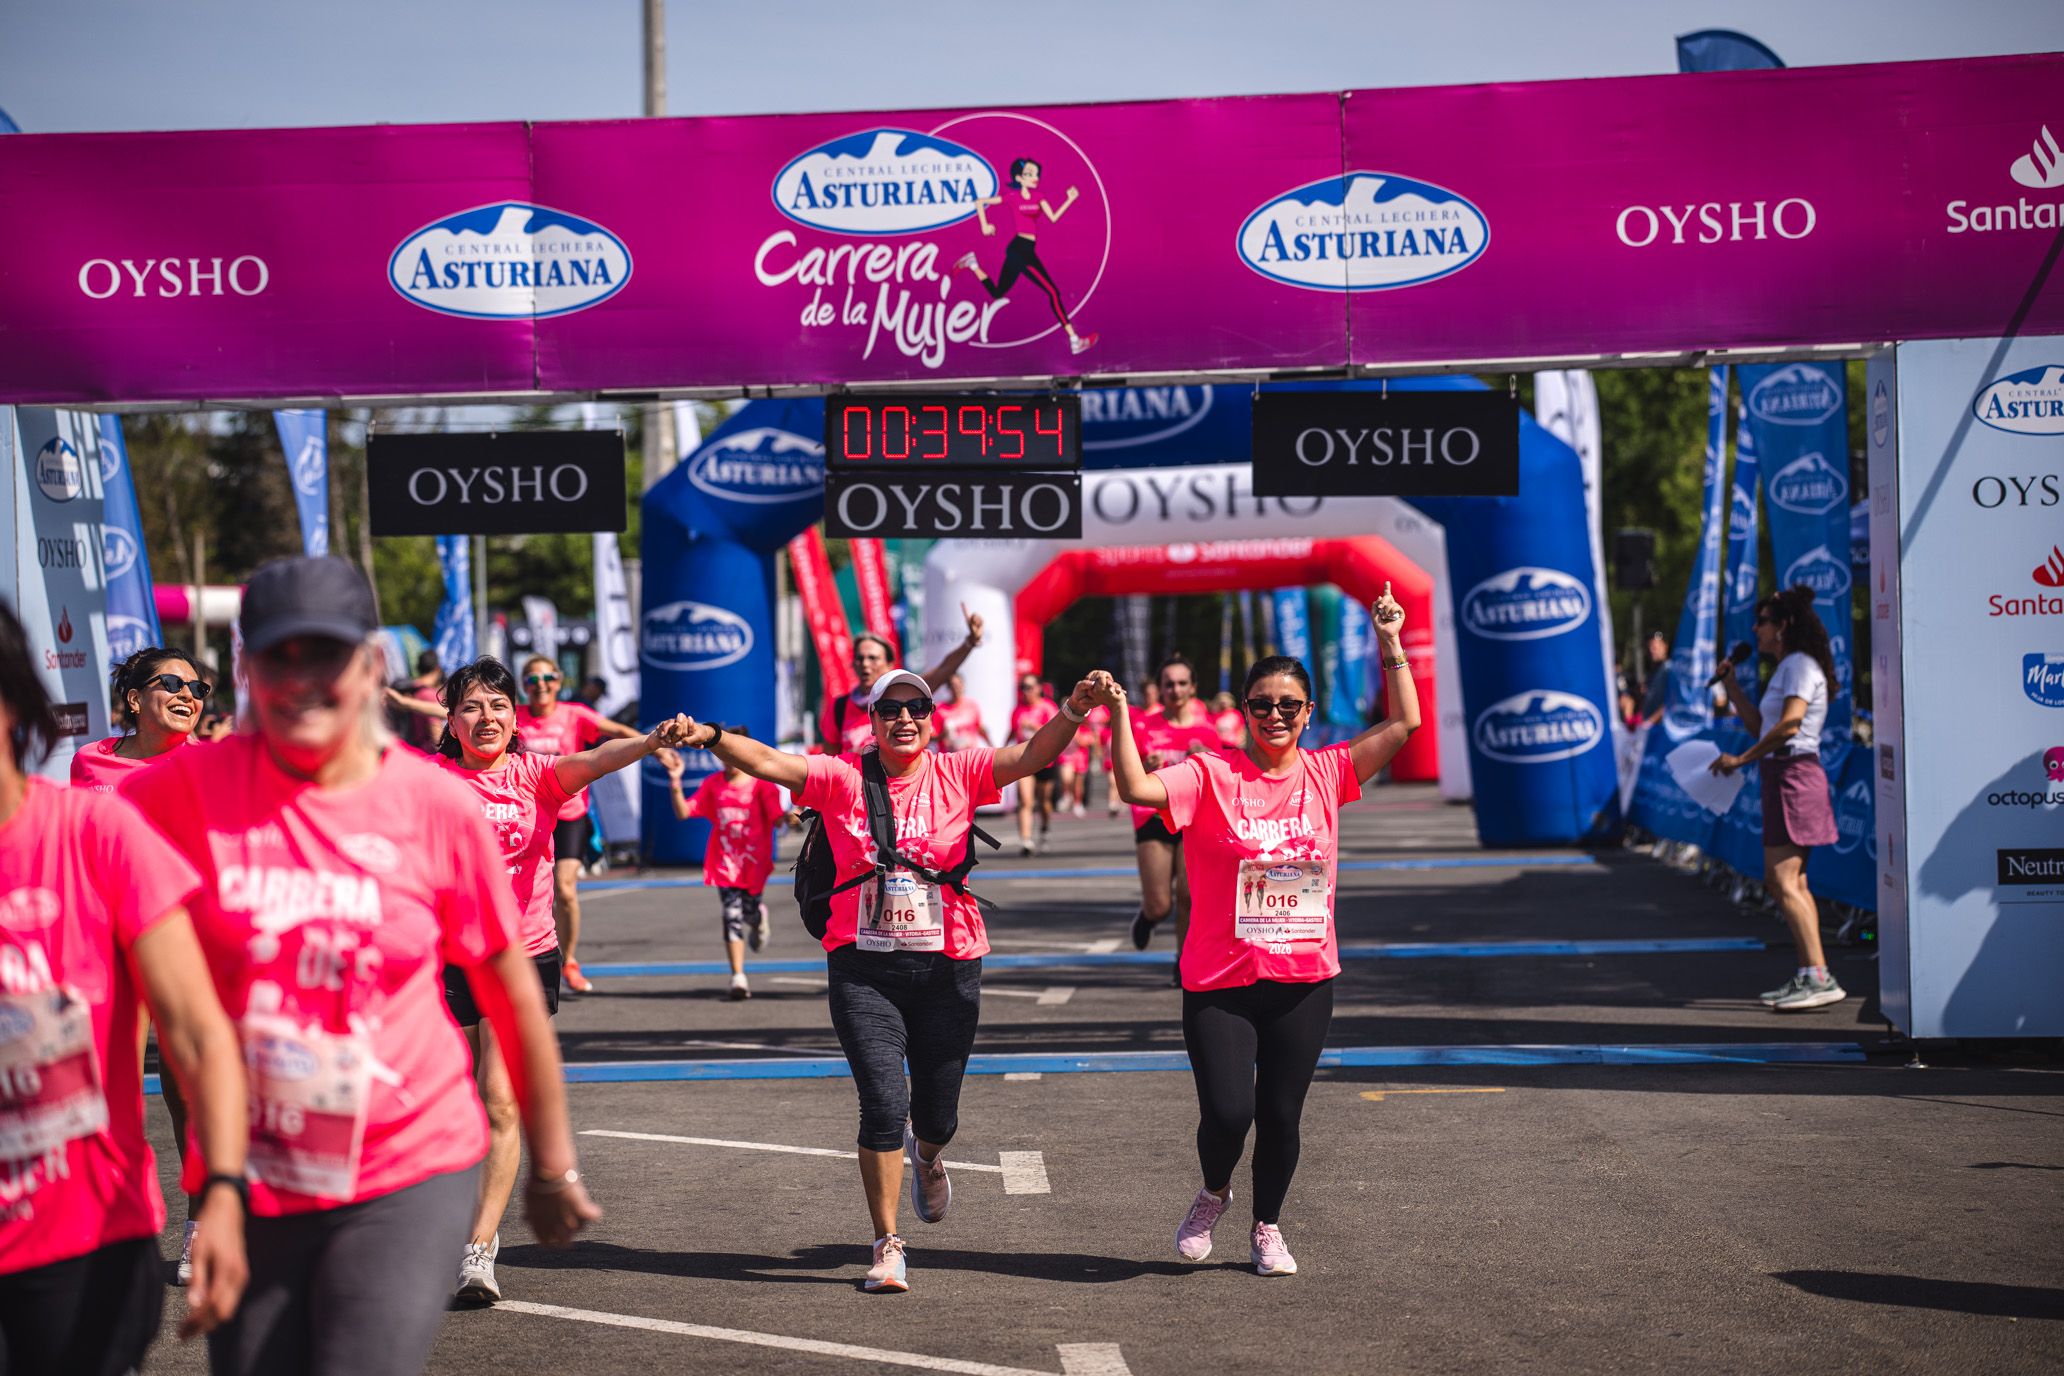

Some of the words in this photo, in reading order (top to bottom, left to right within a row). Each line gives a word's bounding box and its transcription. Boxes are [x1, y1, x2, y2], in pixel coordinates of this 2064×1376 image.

[824, 165, 895, 178] CENTRAL
[902, 162, 973, 175] LECHERA
[791, 171, 979, 210] ASTURIANA
[1295, 212, 1374, 227] CENTRAL
[1380, 209, 1461, 224] LECHERA
[1615, 198, 1818, 248] OYSHO
[1946, 197, 2064, 234] Santa
[444, 244, 522, 256] CENTRAL
[1257, 219, 1471, 263] ASTURIANA
[409, 247, 613, 290] ASTURIANA
[754, 229, 940, 287] Carrera
[77, 254, 270, 300] OYSHO
[800, 286, 836, 327] de
[842, 285, 868, 326] la
[862, 274, 1011, 369] Mujer
[2008, 388, 2059, 398] CENTRAL
[842, 406, 1064, 459] 00:39:54
[1295, 426, 1481, 467] OYSHO
[408, 463, 589, 506] OYSHO
[1972, 474, 2061, 509] OYS
[837, 482, 1071, 533] OYSHO
[38, 537, 87, 569] OYSHO
[1989, 593, 2064, 617] Santa
[45, 649, 87, 671] Santander
[1231, 797, 1266, 808] OYSHO
[1237, 813, 1315, 842] CARRERA
[2006, 855, 2064, 877] Neutr
[883, 909, 916, 922] 016
[1266, 894, 1298, 908] 016
[866, 939, 892, 948] OYSHO
[1246, 926, 1275, 934] OYSHO
